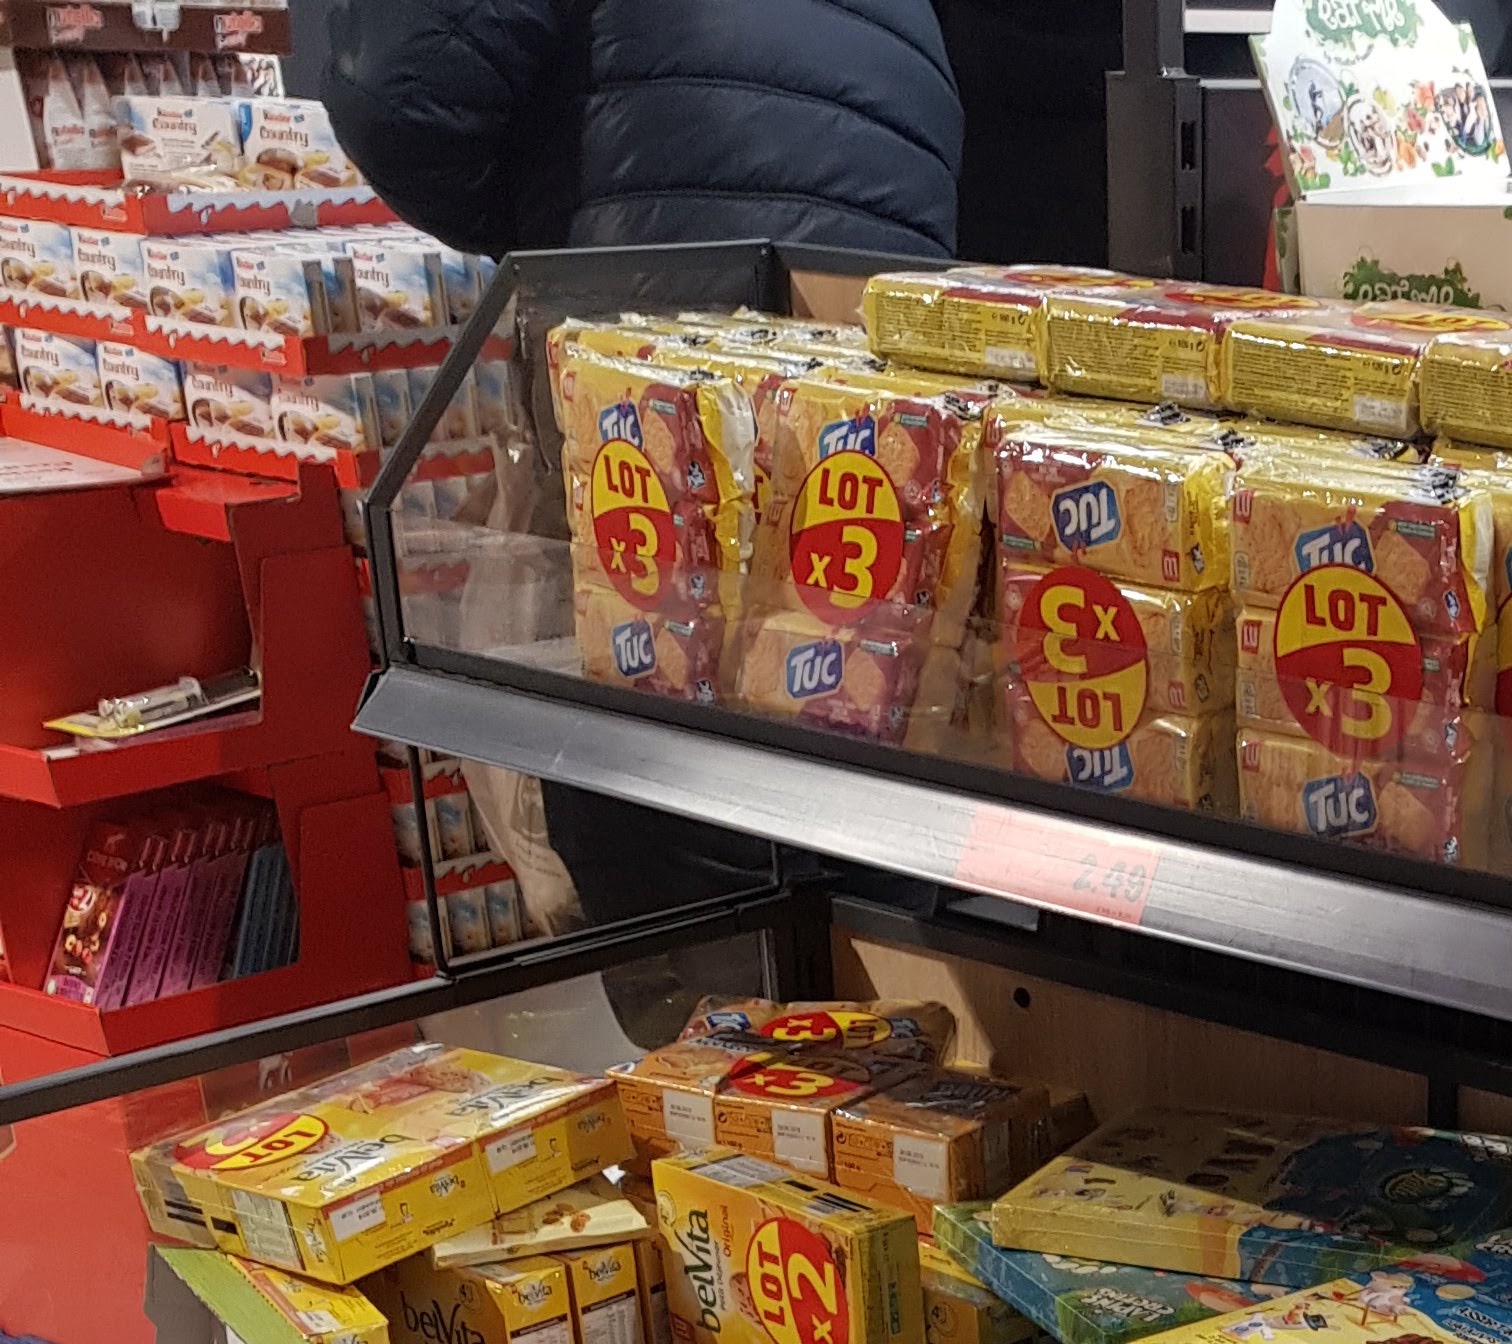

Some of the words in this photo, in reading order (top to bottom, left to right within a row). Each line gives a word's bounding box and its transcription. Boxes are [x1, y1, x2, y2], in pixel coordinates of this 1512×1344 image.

[604, 455, 652, 497] LOT
[817, 475, 878, 515] LOT
[1056, 494, 1120, 546] TUC
[1234, 491, 1252, 519] LU
[1304, 584, 1388, 637] LOT
[614, 627, 655, 668] TUC
[1244, 622, 1260, 650] LU
[789, 646, 839, 687] TUC
[1051, 690, 1122, 733] LOT
[1306, 777, 1375, 831] TUC
[1072, 854, 1147, 903] 2.49
[240, 1128, 318, 1165] LOT
[719, 1204, 734, 1258] Original
[675, 1208, 722, 1334] belVita
[756, 1240, 787, 1327] LOT
